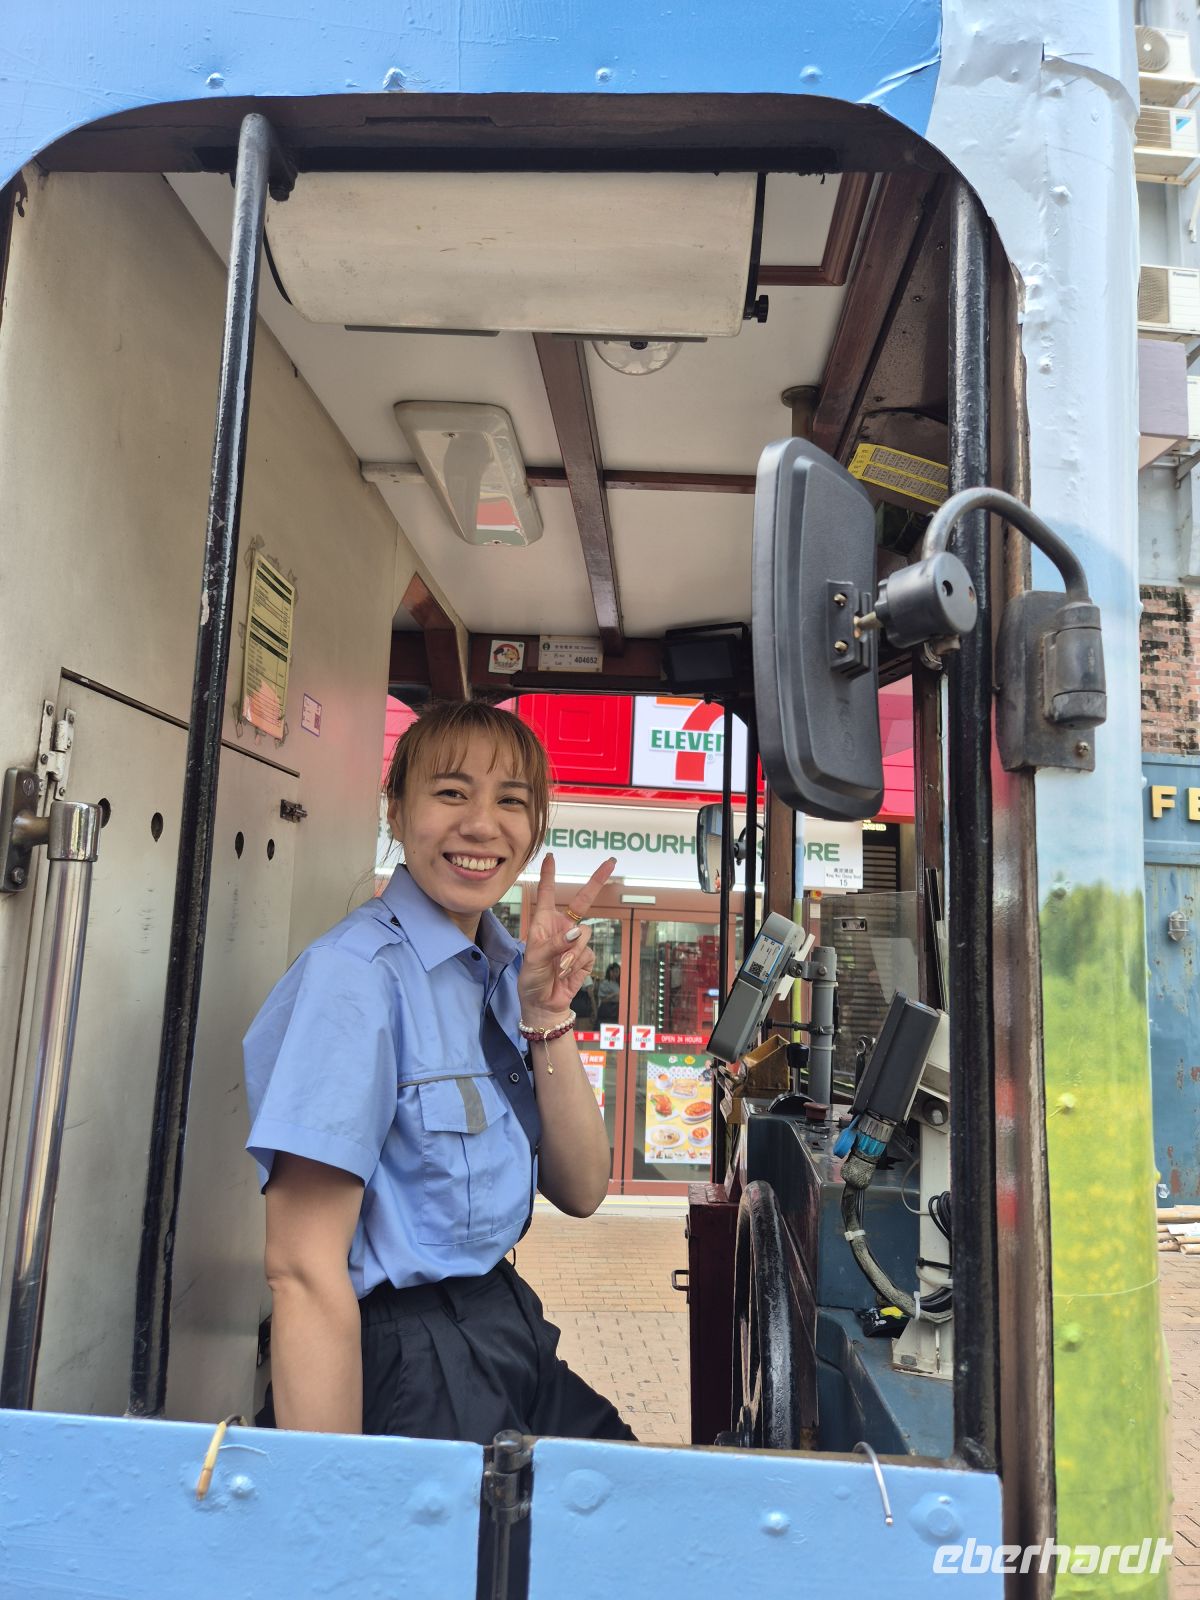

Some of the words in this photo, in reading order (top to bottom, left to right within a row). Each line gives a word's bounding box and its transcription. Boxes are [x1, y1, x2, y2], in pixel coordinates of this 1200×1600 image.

[656, 696, 725, 782] 7
[544, 828, 697, 855] EIGHBOURH
[839, 879, 848, 887] 15
